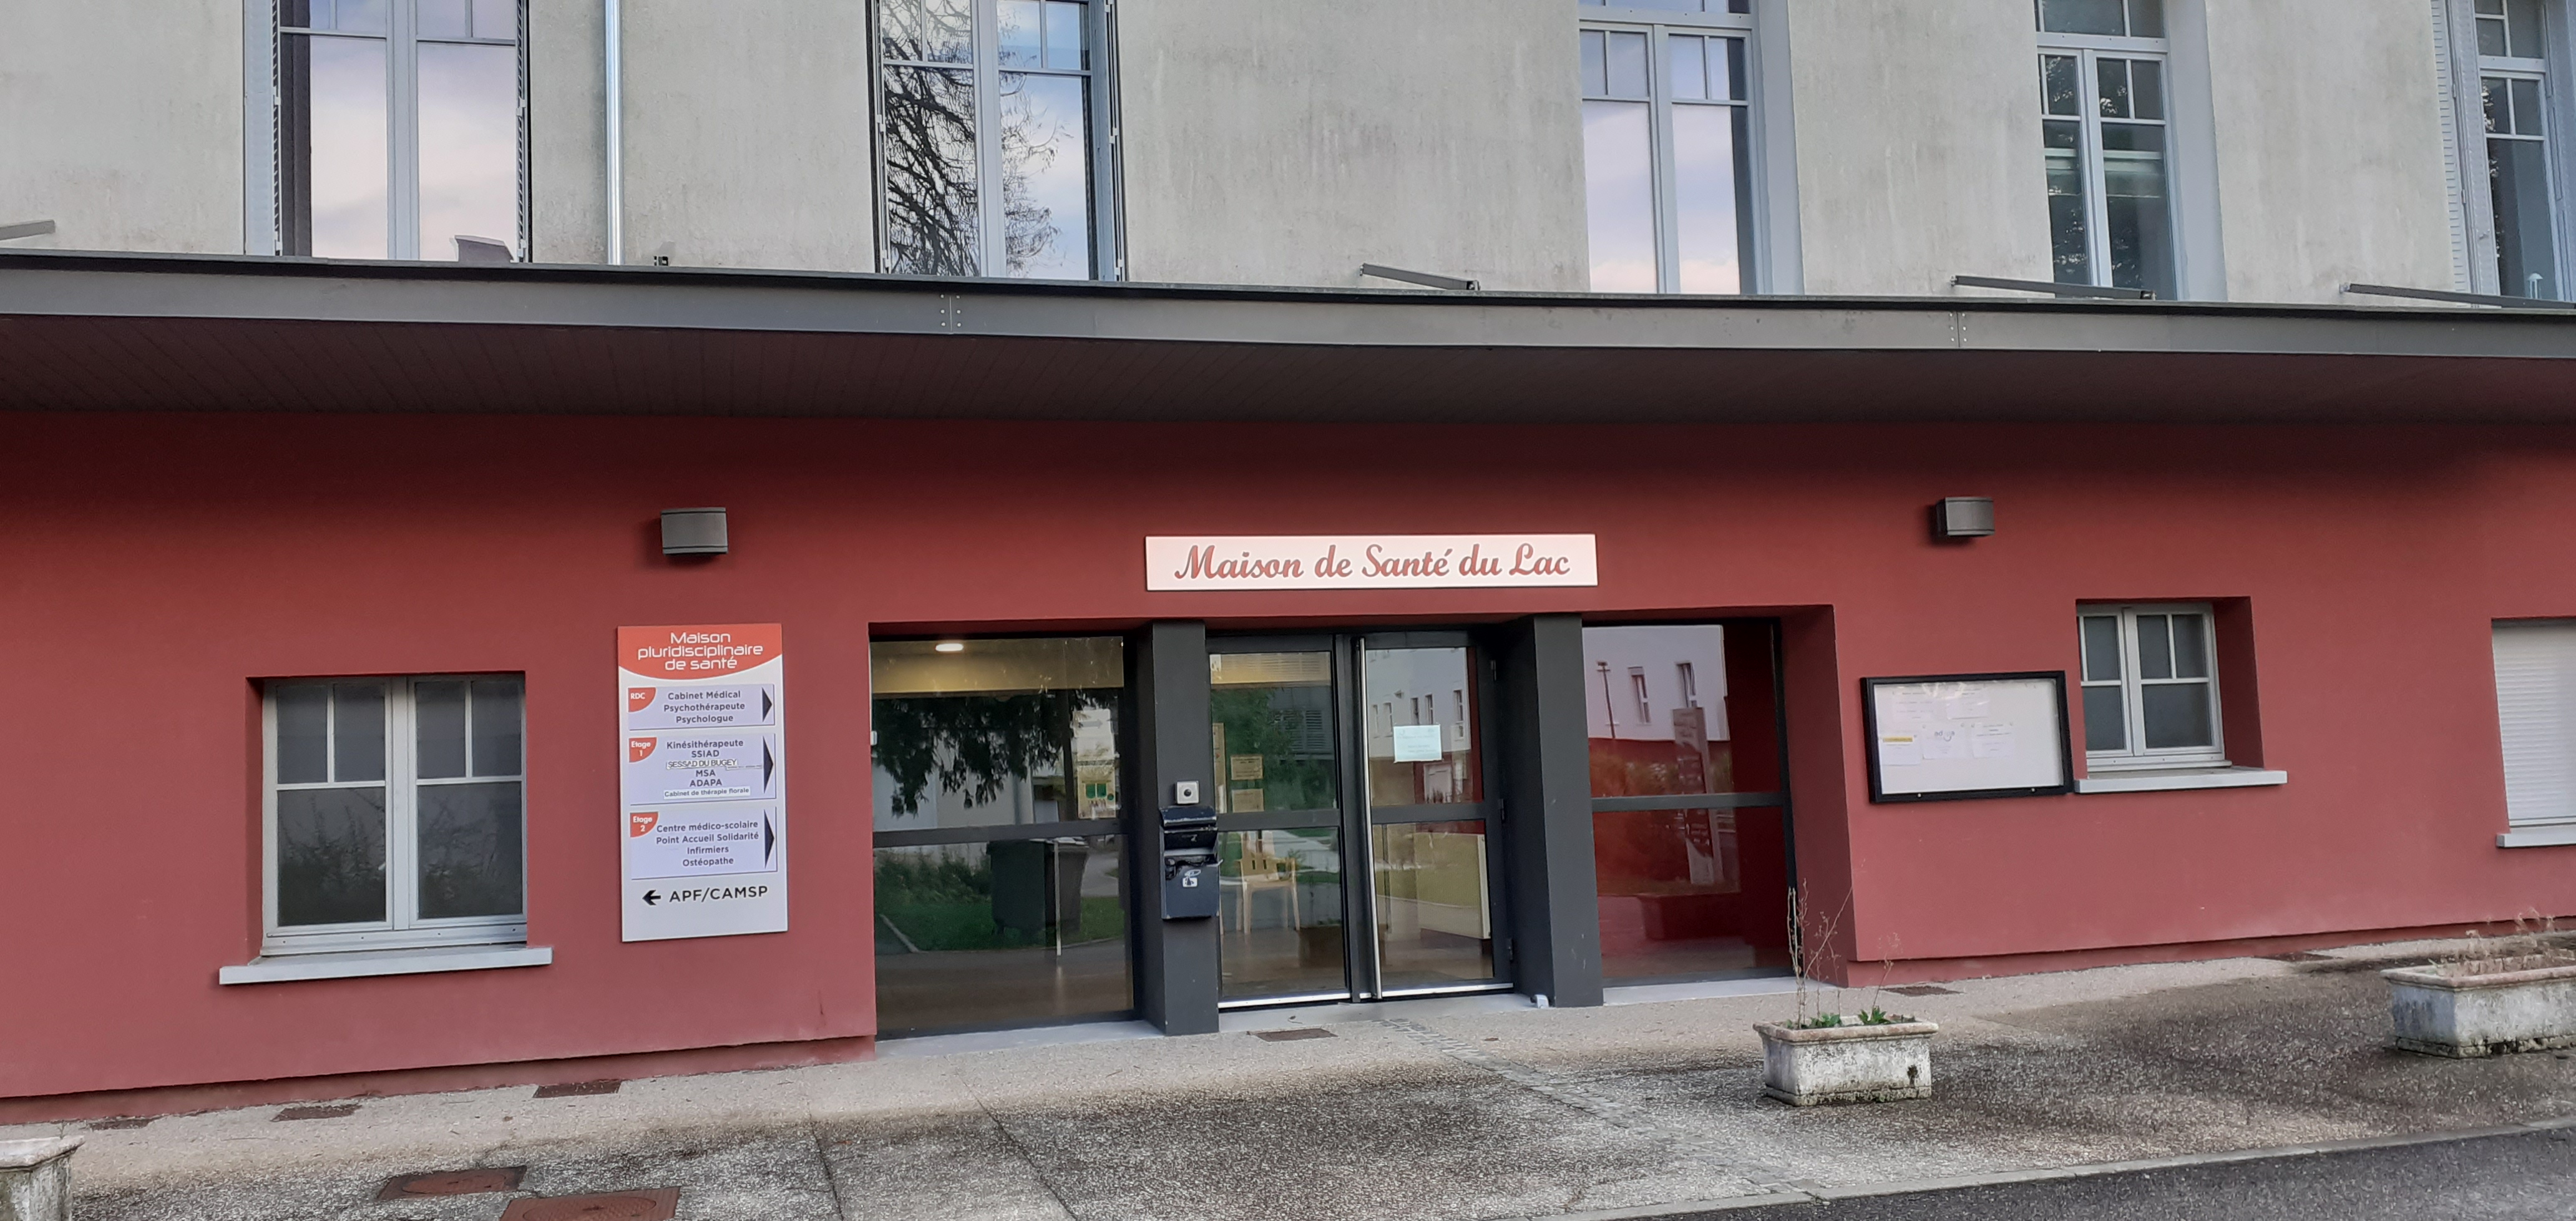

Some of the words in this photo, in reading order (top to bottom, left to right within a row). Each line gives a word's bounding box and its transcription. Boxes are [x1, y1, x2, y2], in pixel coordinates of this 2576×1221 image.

[1174, 545, 1304, 579] Maison
[1314, 546, 1352, 577] de
[1362, 544, 1453, 577] Santé
[1458, 544, 1502, 576] du
[1509, 543, 1571, 576] Lac
[670, 632, 731, 644] Maison
[638, 645, 763, 660] pluridisciplinaire
[665, 659, 686, 670] de
[690, 656, 738, 669] santé
[668, 692, 703, 700] Cabinet
[663, 702, 745, 712] Psychothérapeute
[676, 715, 734, 724] Psychologue
[666, 740, 744, 750] Kinésithérapeute
[690, 779, 722, 787] ADAPA
[701, 788, 727, 797] thérapie
[656, 825, 686, 833] Centre
[688, 821, 758, 831] médico-scolaire
[682, 834, 714, 843] Accueil
[717, 832, 759, 841] Solidarité
[687, 846, 729, 855] Infirmiers
[683, 858, 734, 867] Ostéopathe
[669, 886, 768, 903] APF/CAMSP
